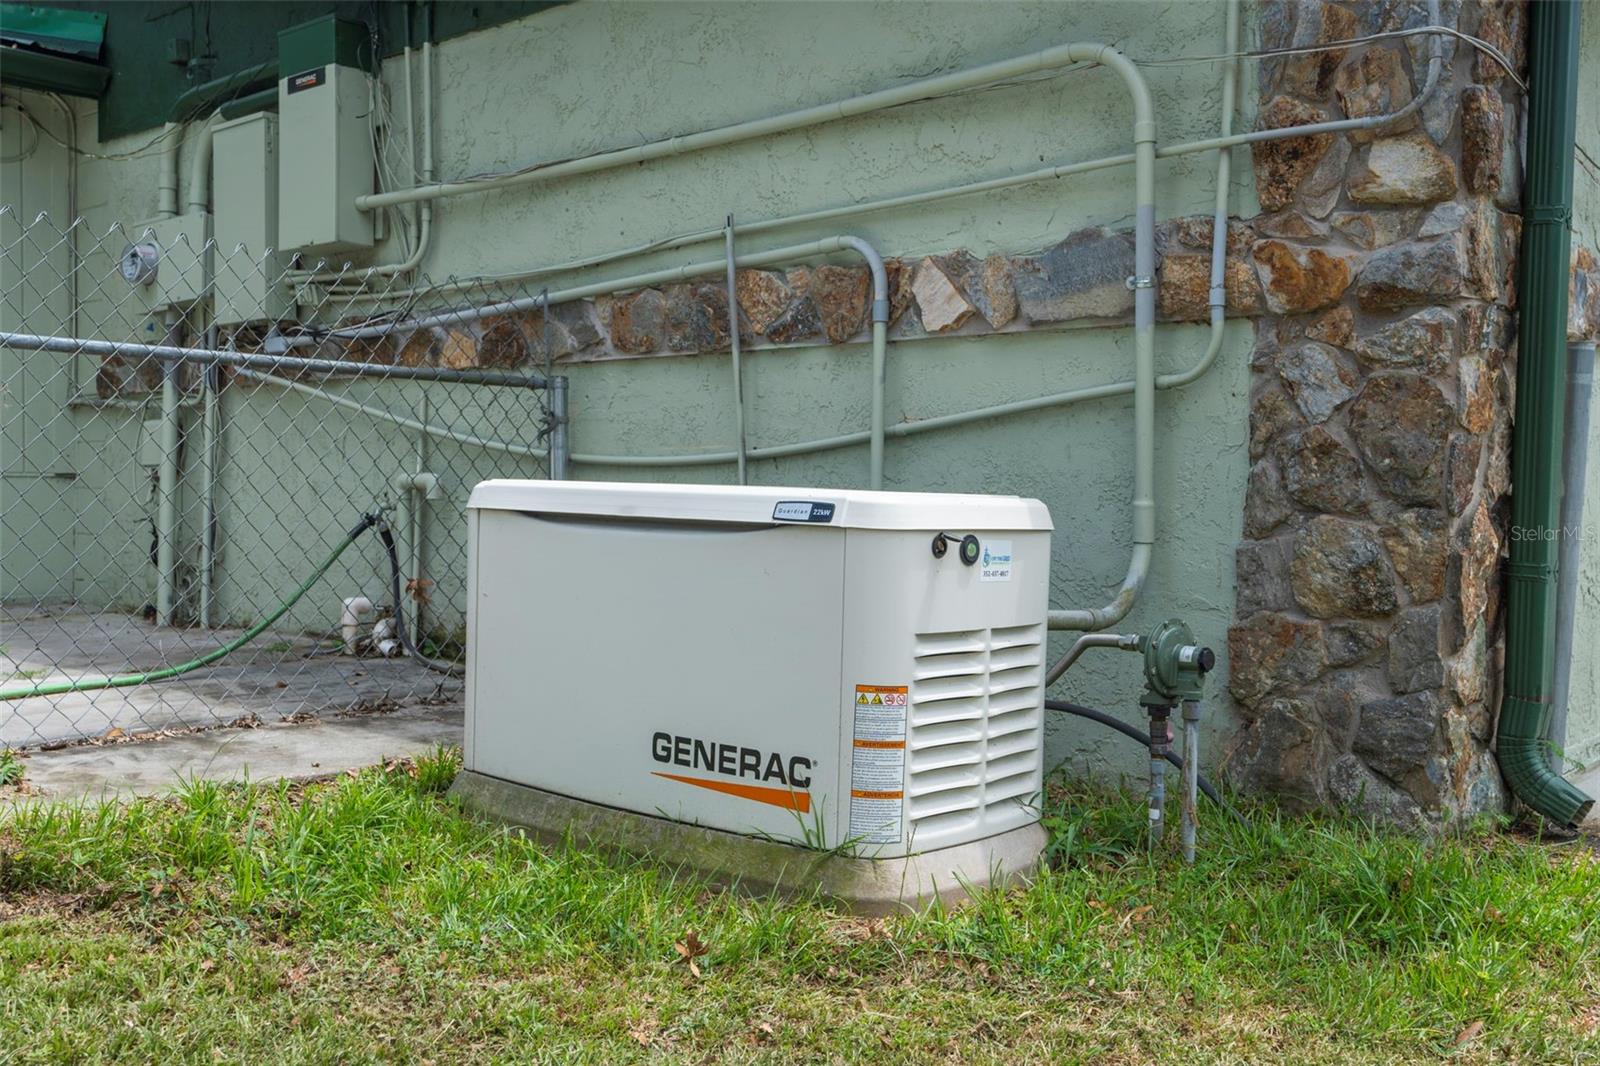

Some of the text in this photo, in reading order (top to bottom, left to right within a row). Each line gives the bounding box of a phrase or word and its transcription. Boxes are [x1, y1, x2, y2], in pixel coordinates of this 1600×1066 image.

[778, 507, 832, 516] Guardian 22kW
[652, 731, 812, 788] GENERAC
